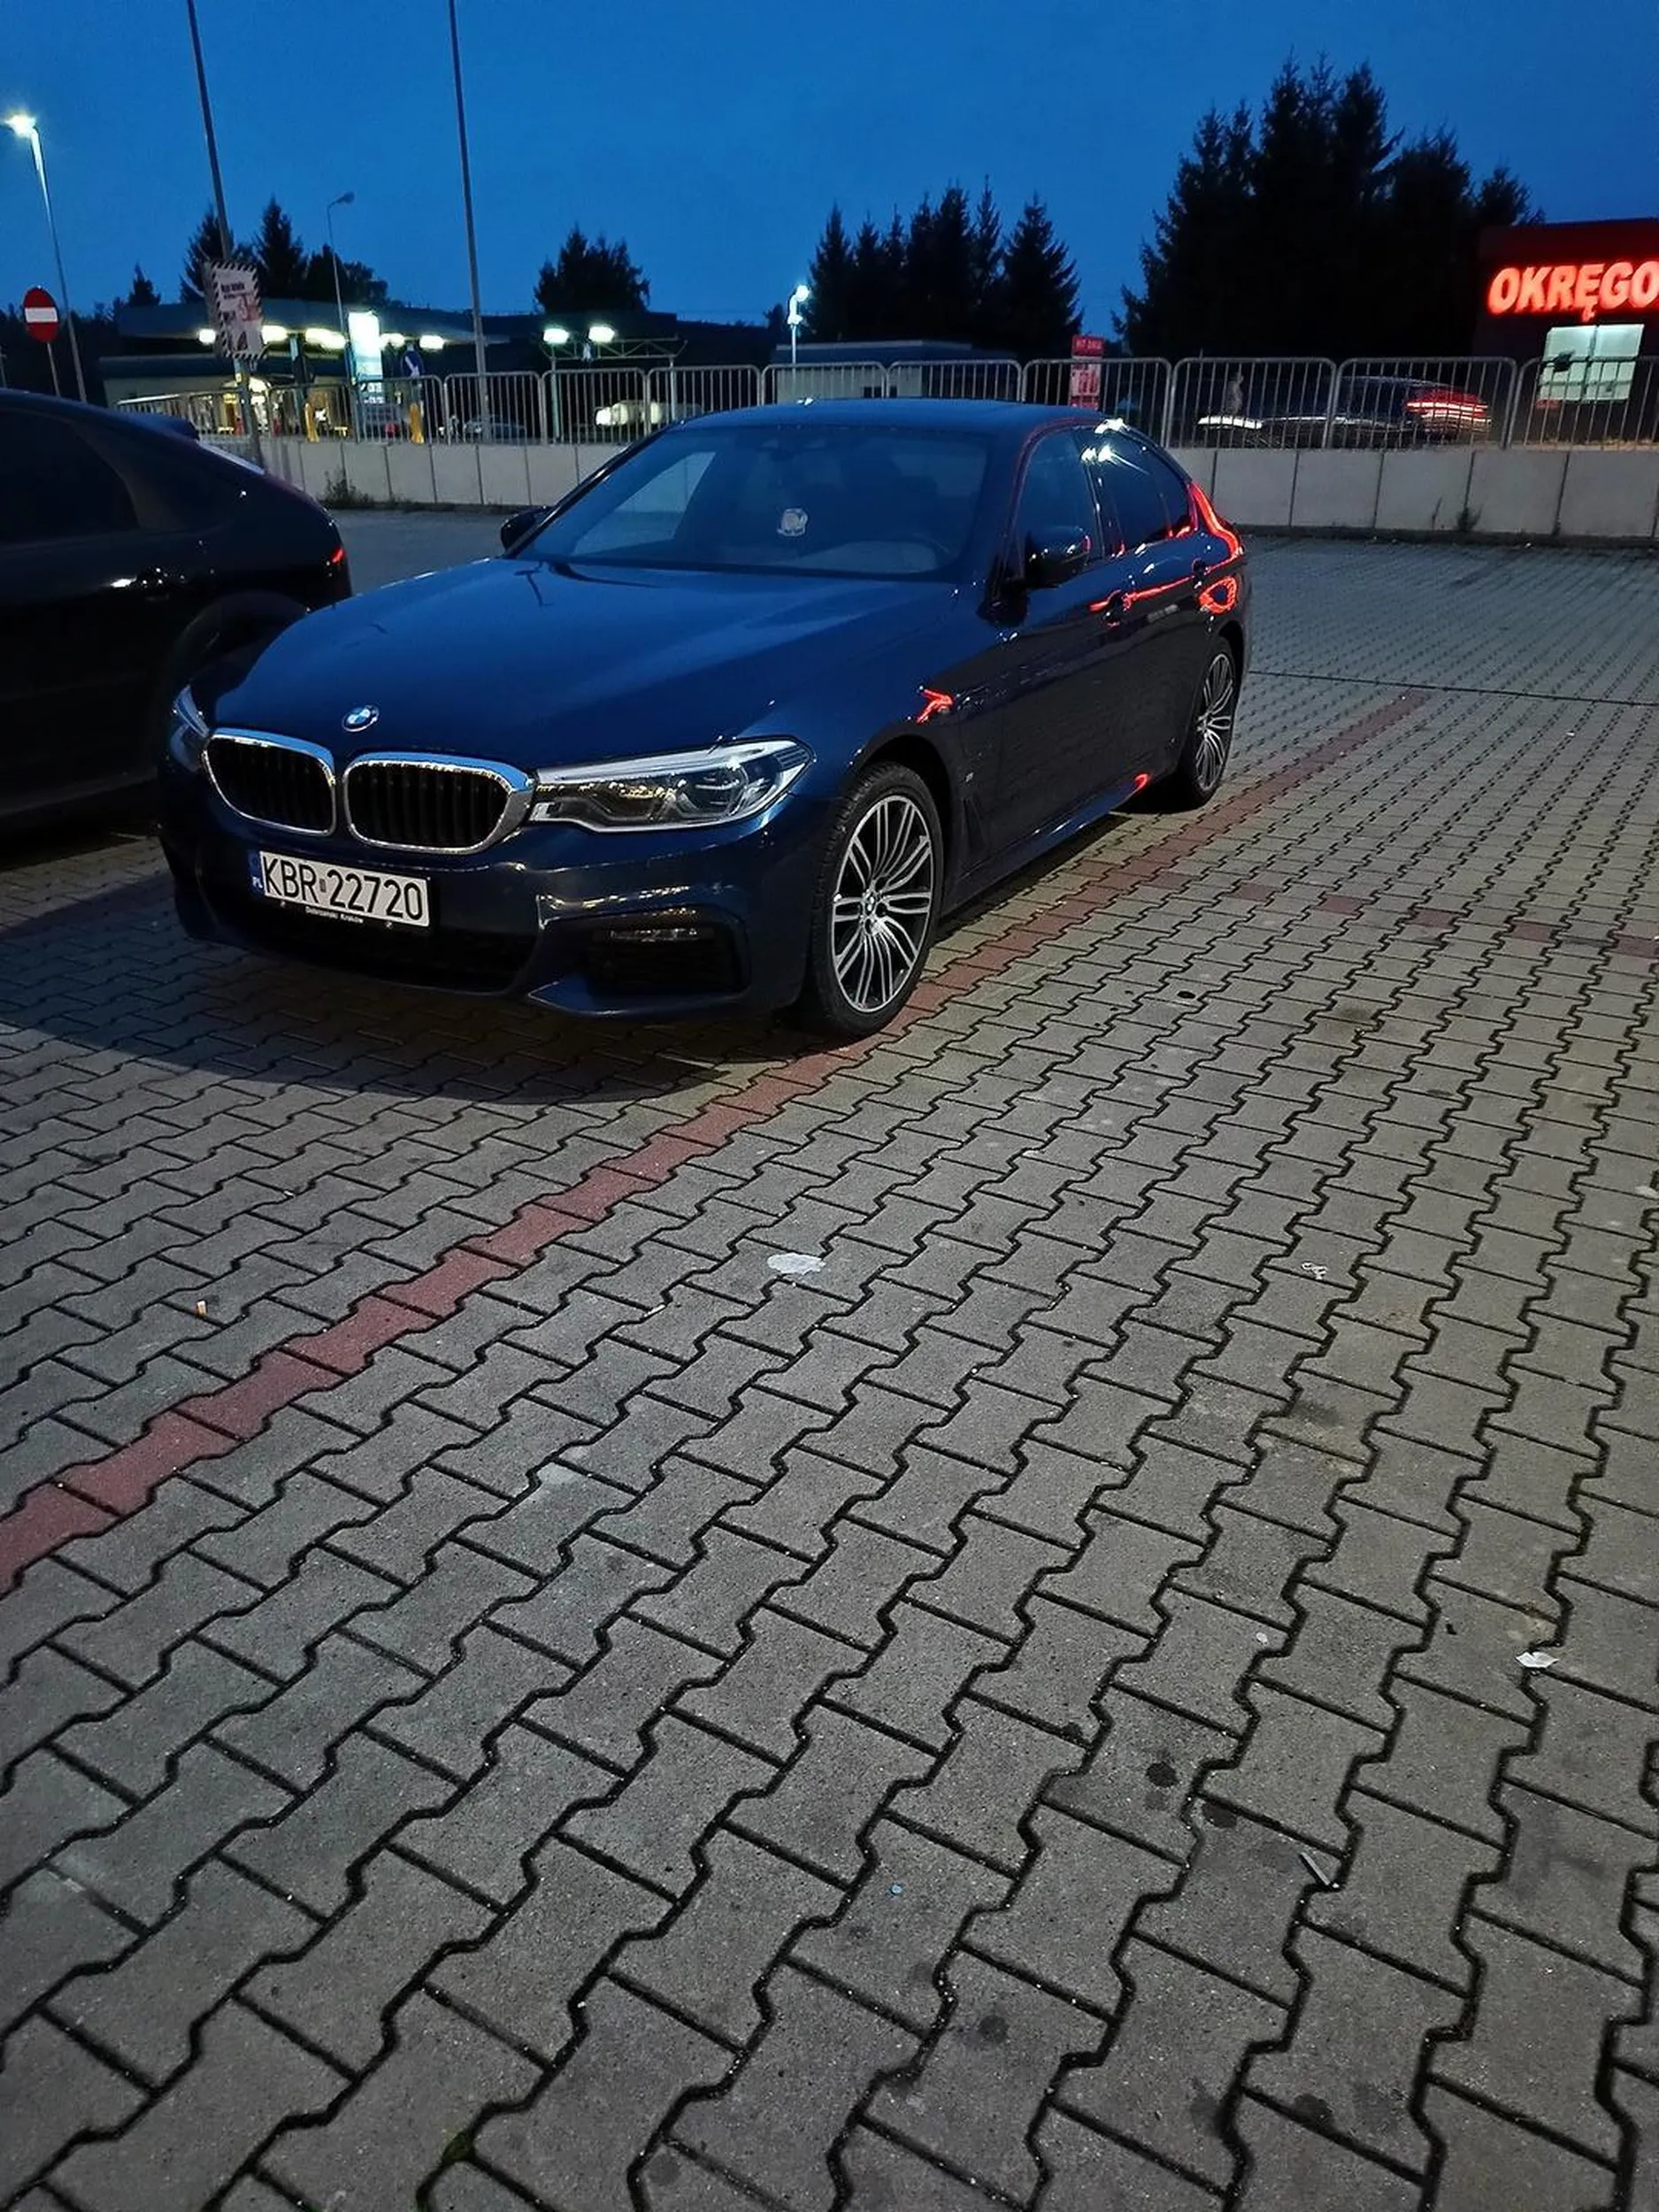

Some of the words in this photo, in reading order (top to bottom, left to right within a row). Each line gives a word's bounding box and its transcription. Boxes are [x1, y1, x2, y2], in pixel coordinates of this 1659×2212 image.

[252, 876, 264, 889] PL
[263, 856, 319, 902] KBR
[326, 869, 423, 920] 22720
